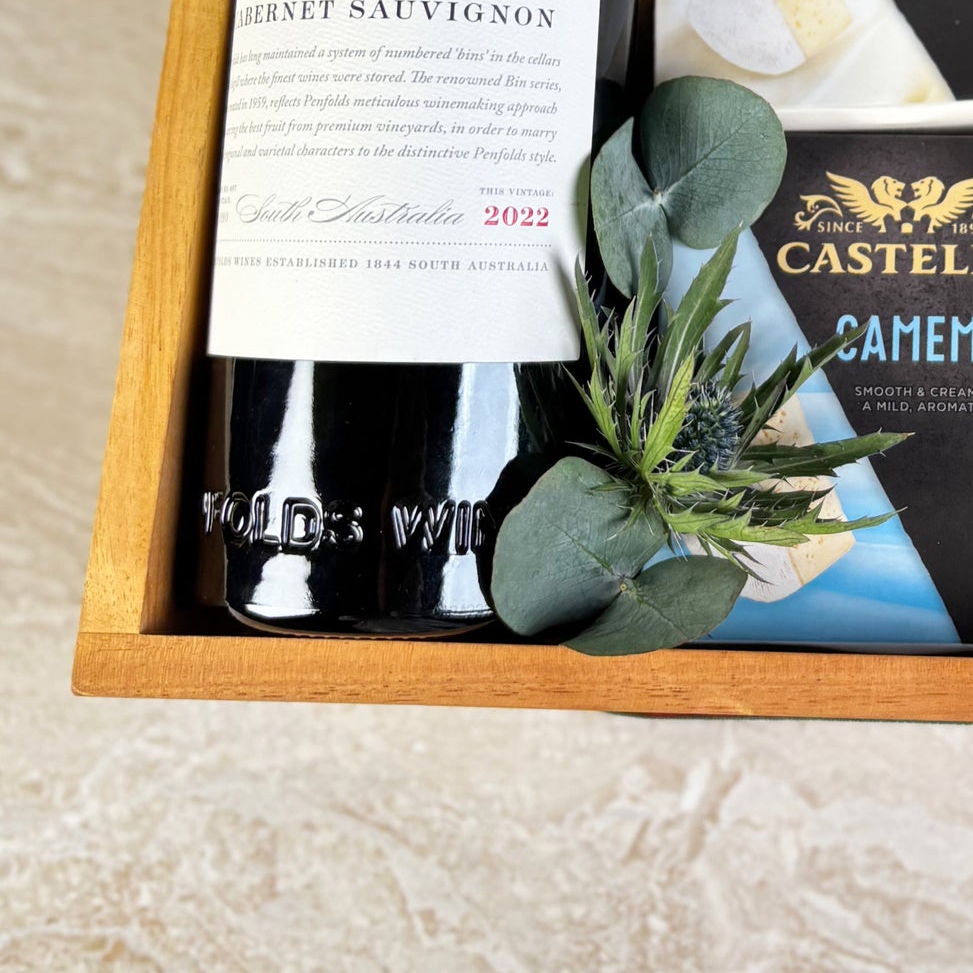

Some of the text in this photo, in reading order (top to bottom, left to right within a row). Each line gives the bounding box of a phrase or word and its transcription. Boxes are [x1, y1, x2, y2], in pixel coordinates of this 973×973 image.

[237, 0, 335, 29] ABERNET
[263, 45, 316, 59] maintained
[317, 49, 325, 58] a
[327, 47, 367, 62] system
[369, 45, 386, 62] of
[384, 46, 452, 60] numbered
[490, 50, 503, 63] in
[506, 50, 525, 64] the
[528, 53, 561, 67] cellars
[257, 72, 270, 85] the
[269, 70, 296, 88] finest
[299, 72, 330, 84] wines
[332, 72, 363, 83] were
[364, 70, 407, 84] stored.
[411, 69, 432, 84] The
[436, 75, 501, 88] renowned
[505, 74, 527, 88] Bin
[529, 77, 562, 93] series,
[270, 95, 301, 113] reflects
[303, 93, 351, 112] Penfolds
[353, 93, 420, 108] meticulous
[423, 96, 504, 115] winemaking
[507, 102, 558, 118] approach
[262, 119, 286, 137] fruit
[285, 118, 313, 137] from
[315, 119, 372, 137] premium
[376, 119, 447, 137] vineyards,
[451, 121, 465, 135] in
[468, 122, 502, 136] order
[506, 125, 518, 137] to
[521, 128, 558, 143] marry
[258, 144, 297, 158] varietal
[296, 144, 355, 158] characters
[357, 145, 370, 158] to
[373, 144, 393, 158] the
[397, 145, 470, 160] distinctive
[473, 146, 526, 165] Penfolds
[528, 149, 558, 167] style.
[479, 187, 556, 198] THIS VINTAGE:
[236, 193, 313, 225] South
[308, 194, 465, 225] Australia
[484, 205, 550, 227] 2022
[817, 221, 863, 233] SINCE
[266, 257, 359, 269] ESTABLISHED
[365, 258, 402, 270] 1844
[408, 259, 461, 270] SOUTH
[467, 260, 549, 272] AUSTRALIA
[854, 386, 913, 398] SMOOTH
[917, 386, 926, 398] &
[862, 401, 872, 412] A
[876, 401, 913, 414] MILD,
